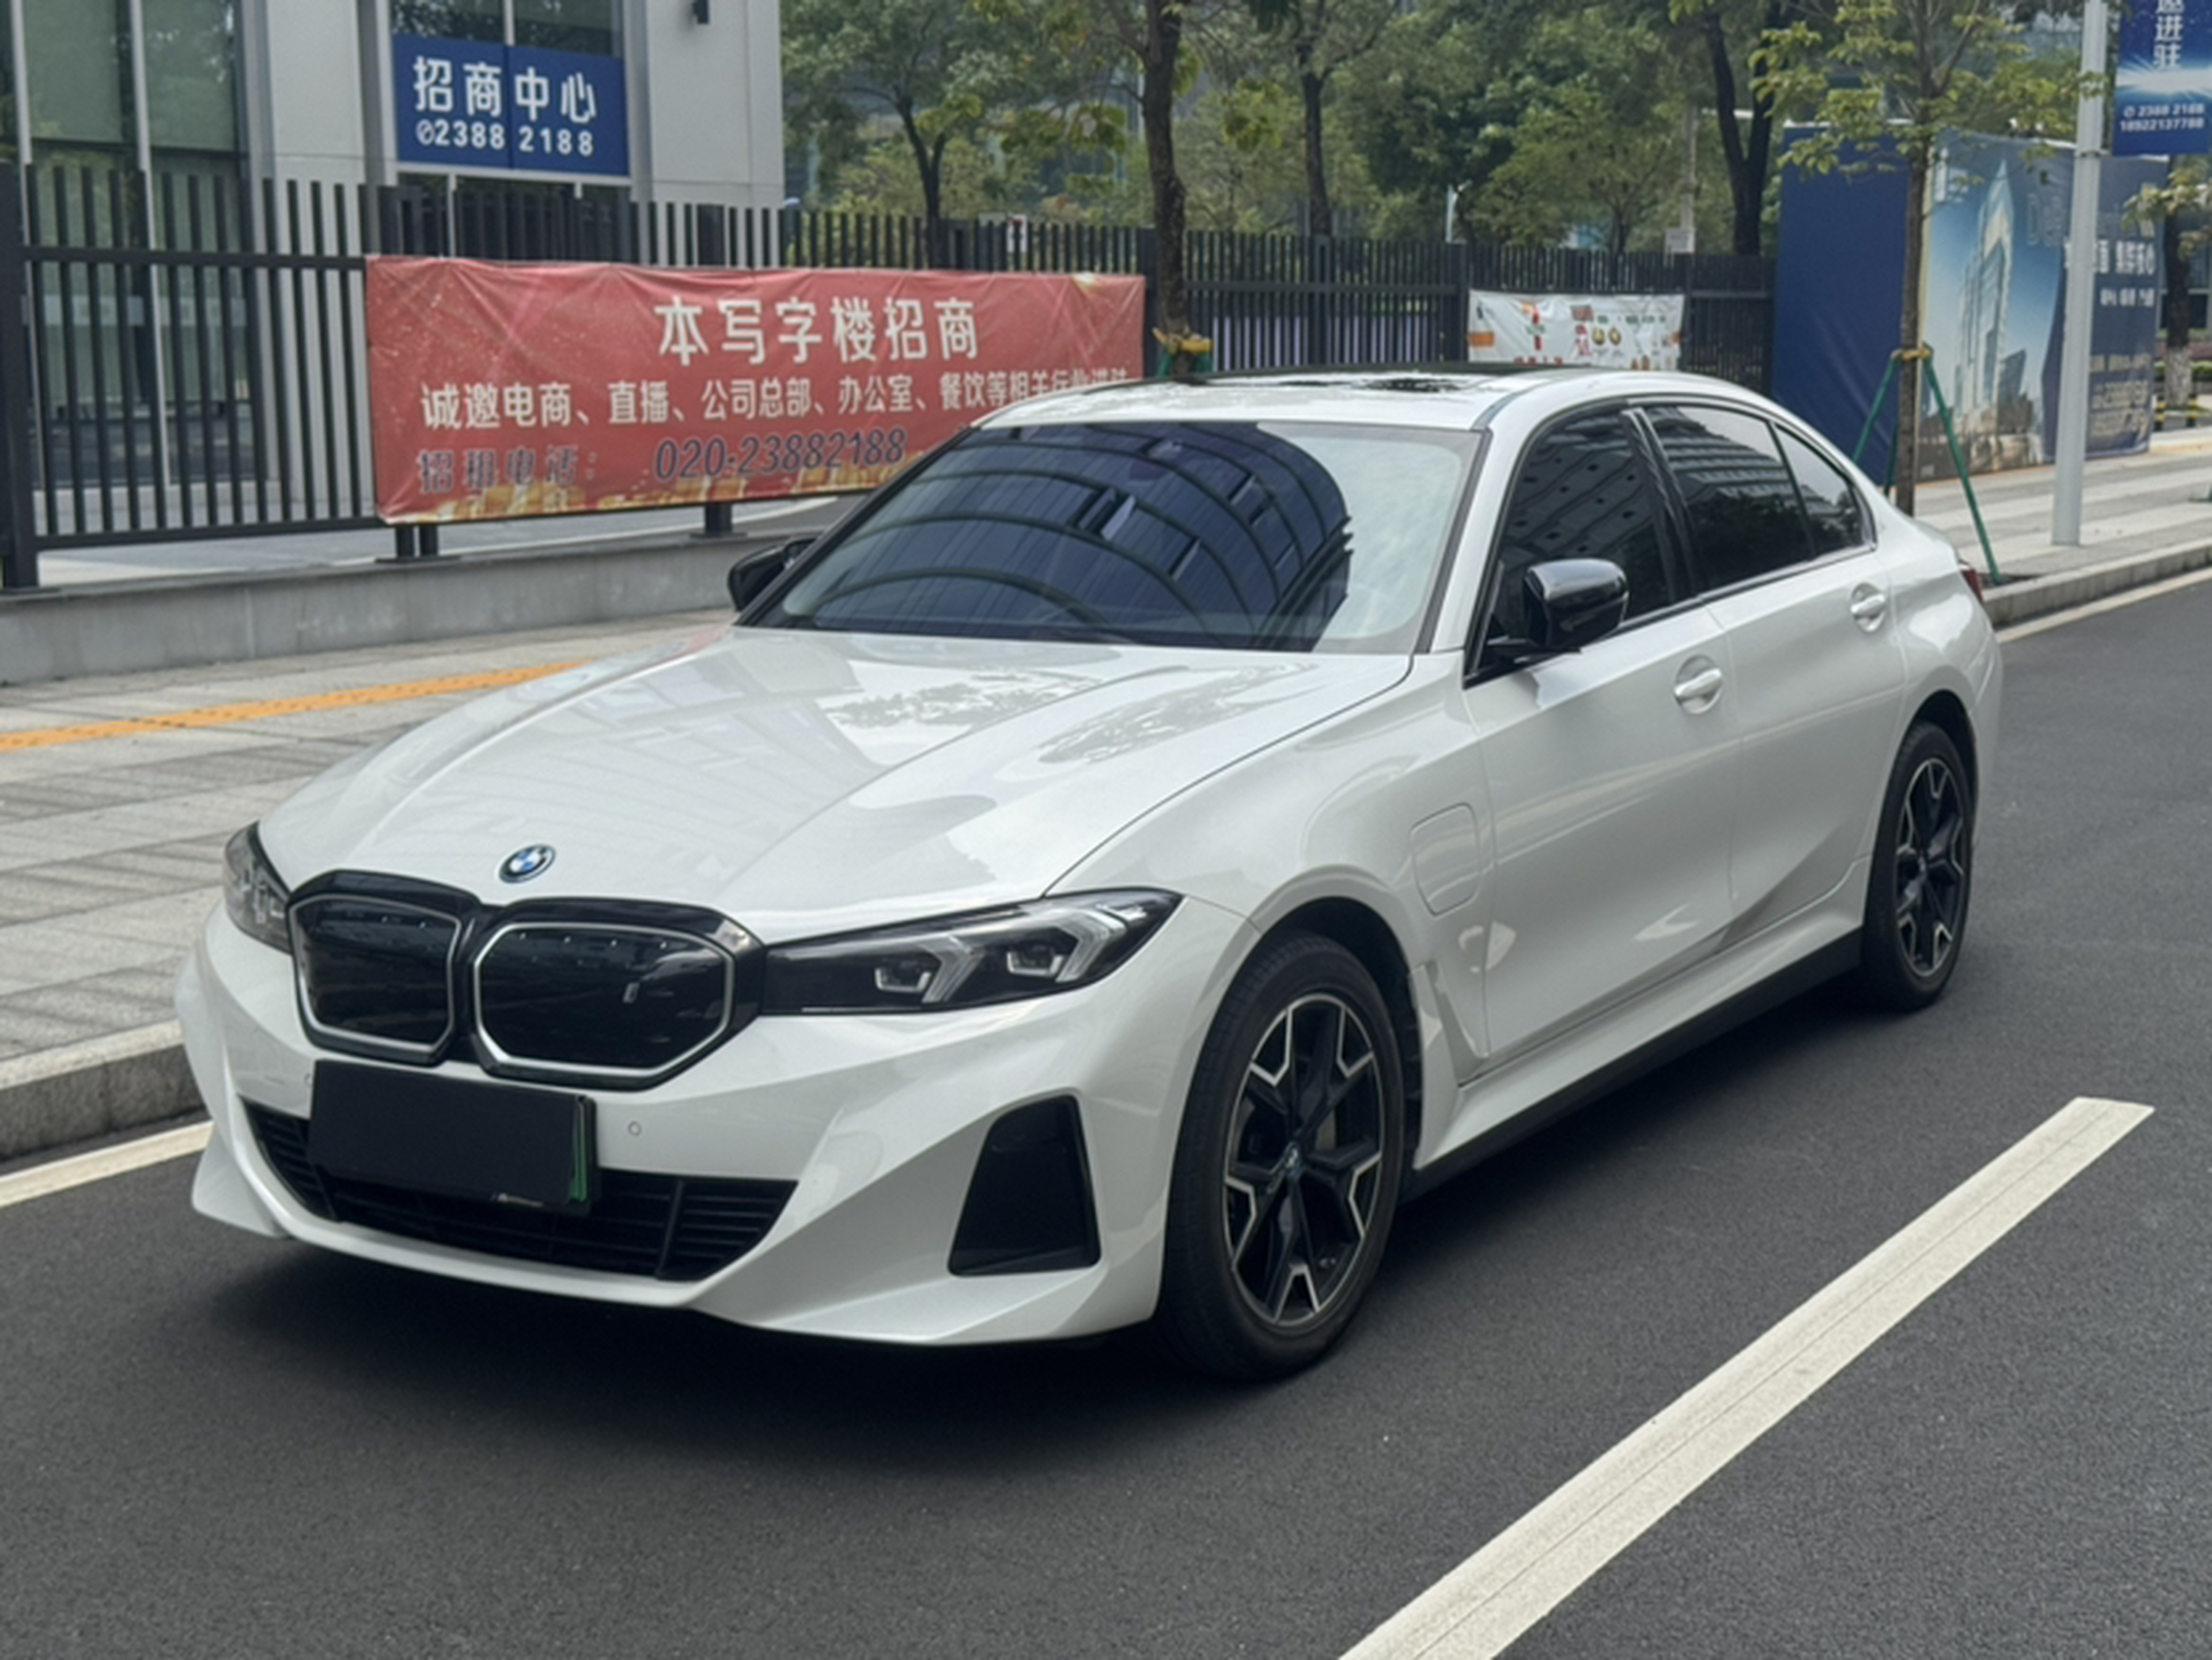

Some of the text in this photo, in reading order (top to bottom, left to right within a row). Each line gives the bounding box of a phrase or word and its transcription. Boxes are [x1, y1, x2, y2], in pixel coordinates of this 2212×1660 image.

[413, 55, 597, 123] 招商中心
[434, 119, 593, 156] 2388 2188
[654, 295, 978, 366] 本写字楼招商
[654, 429, 907, 483] 020-23882188
